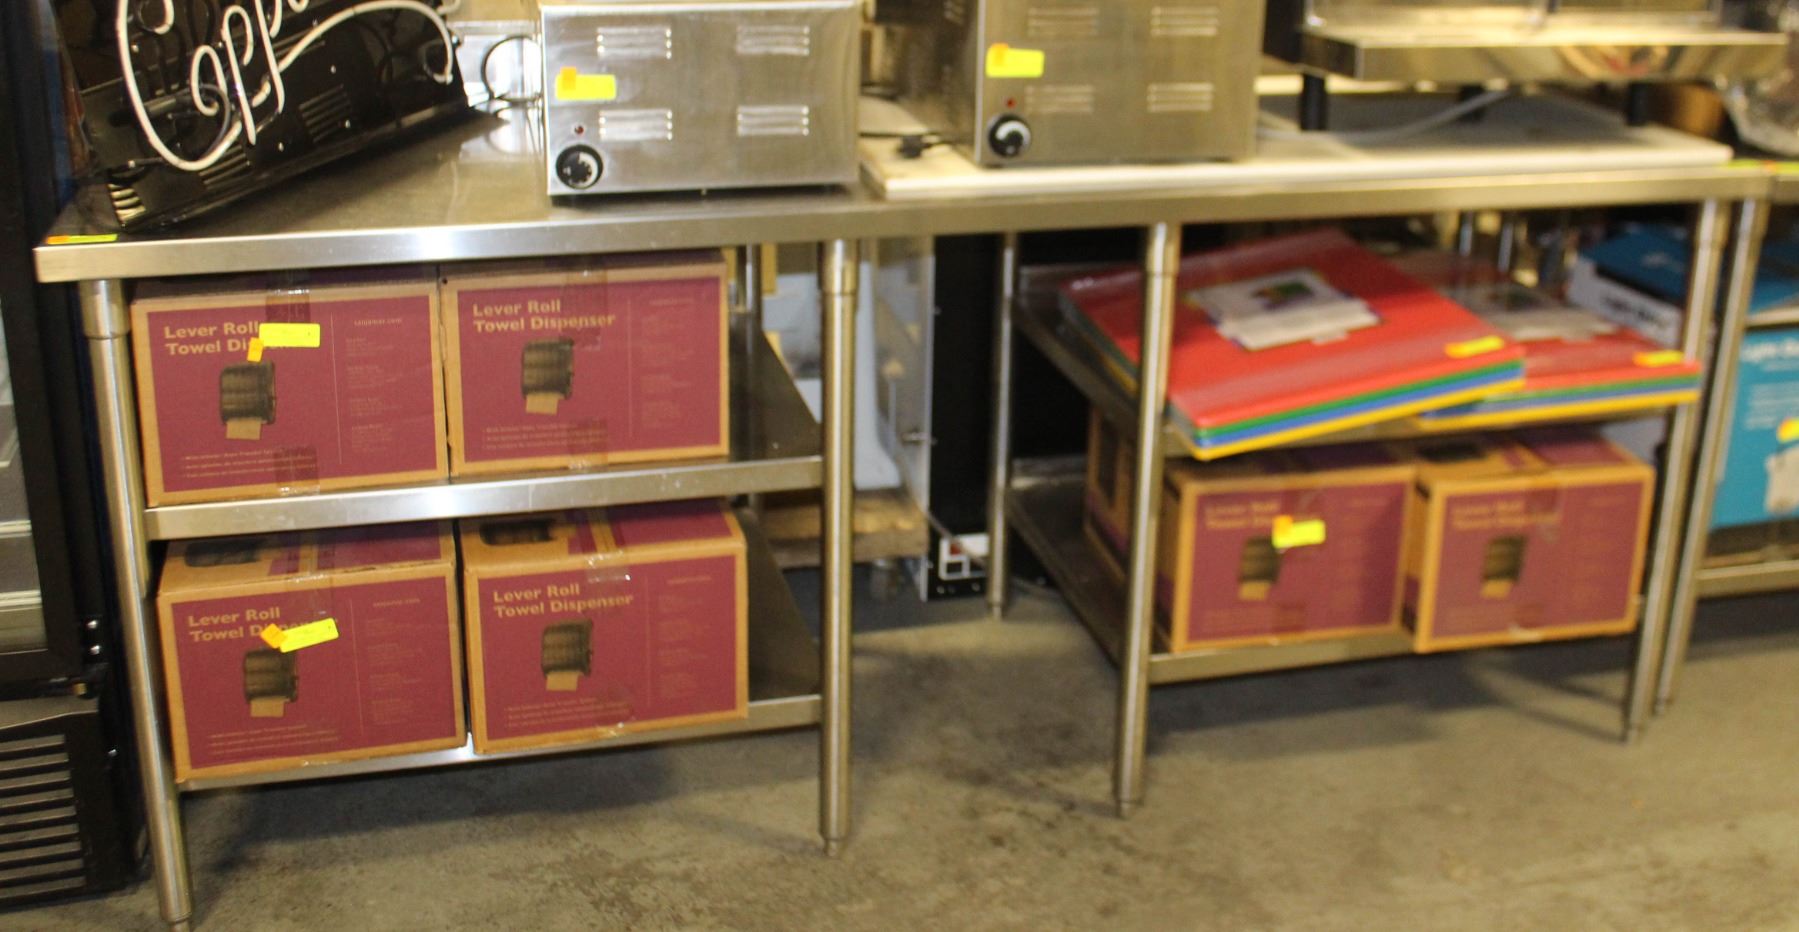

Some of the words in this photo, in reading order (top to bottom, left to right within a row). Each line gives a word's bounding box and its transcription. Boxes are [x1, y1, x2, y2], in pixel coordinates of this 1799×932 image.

[473, 302, 522, 317] Lever
[528, 299, 561, 314] Roll
[163, 324, 217, 339] Lever
[223, 321, 259, 336] Roll
[474, 319, 525, 333] Towel
[530, 314, 616, 331] Dispenser
[166, 341, 221, 356] Towel
[493, 587, 542, 604] Lever
[547, 583, 580, 598] Roll
[494, 604, 545, 619] Towel
[551, 594, 634, 613] Dispenser
[188, 612, 240, 628] Lever
[246, 607, 281, 622] Roll
[190, 628, 245, 643] Towel
